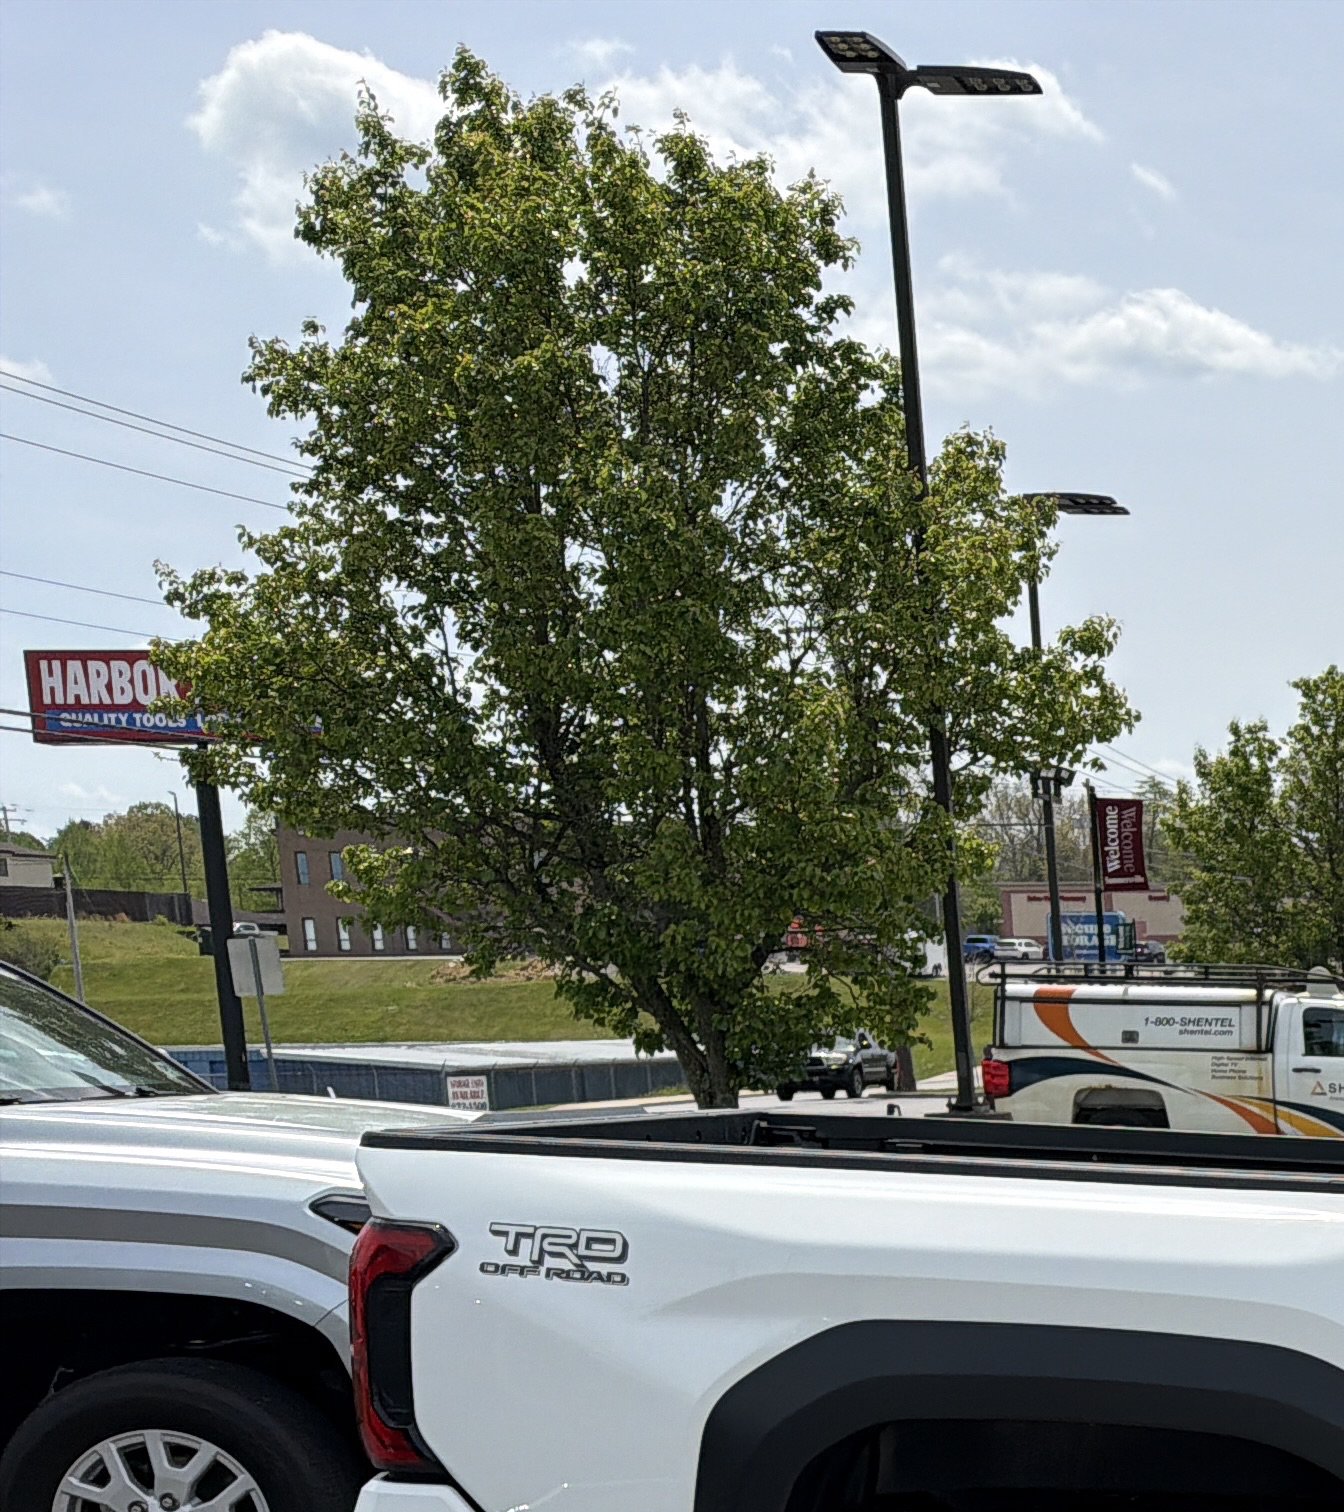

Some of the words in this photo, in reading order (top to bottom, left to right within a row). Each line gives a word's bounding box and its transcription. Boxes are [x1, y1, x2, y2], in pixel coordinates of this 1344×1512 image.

[60, 712, 128, 728] QUALITY
[1104, 805, 1121, 873] Welcome
[1120, 806, 1137, 873] Welcome
[1144, 1016, 1236, 1028] 1-800-SHENTEL
[1178, 1028, 1234, 1037] shentel.com
[489, 1222, 629, 1272] TRD
[479, 1262, 541, 1278] OFF
[545, 1266, 629, 1286] ROAD
